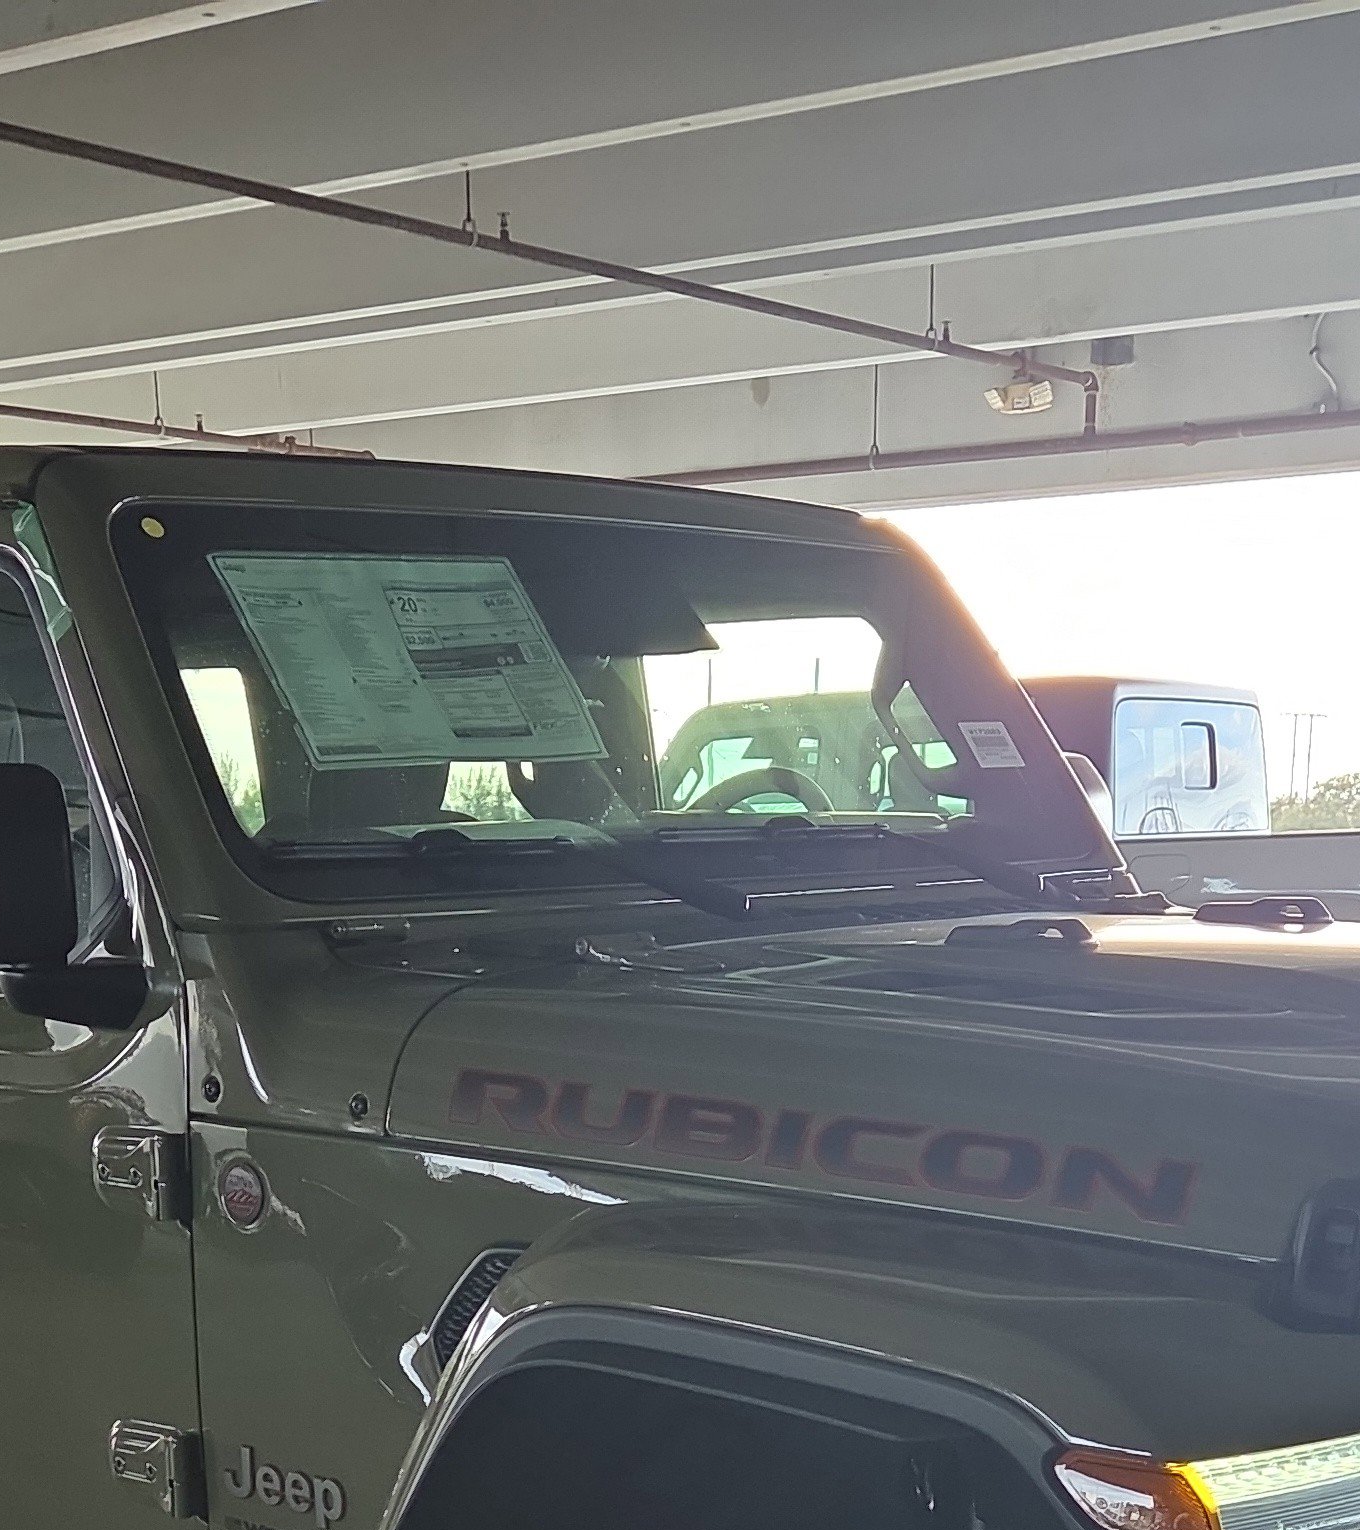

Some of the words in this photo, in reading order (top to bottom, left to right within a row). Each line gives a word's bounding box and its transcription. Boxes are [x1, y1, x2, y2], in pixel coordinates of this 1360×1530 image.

[397, 596, 419, 613] 20
[447, 1067, 1202, 1227] RUBICON
[223, 1443, 348, 1530] Jeep
